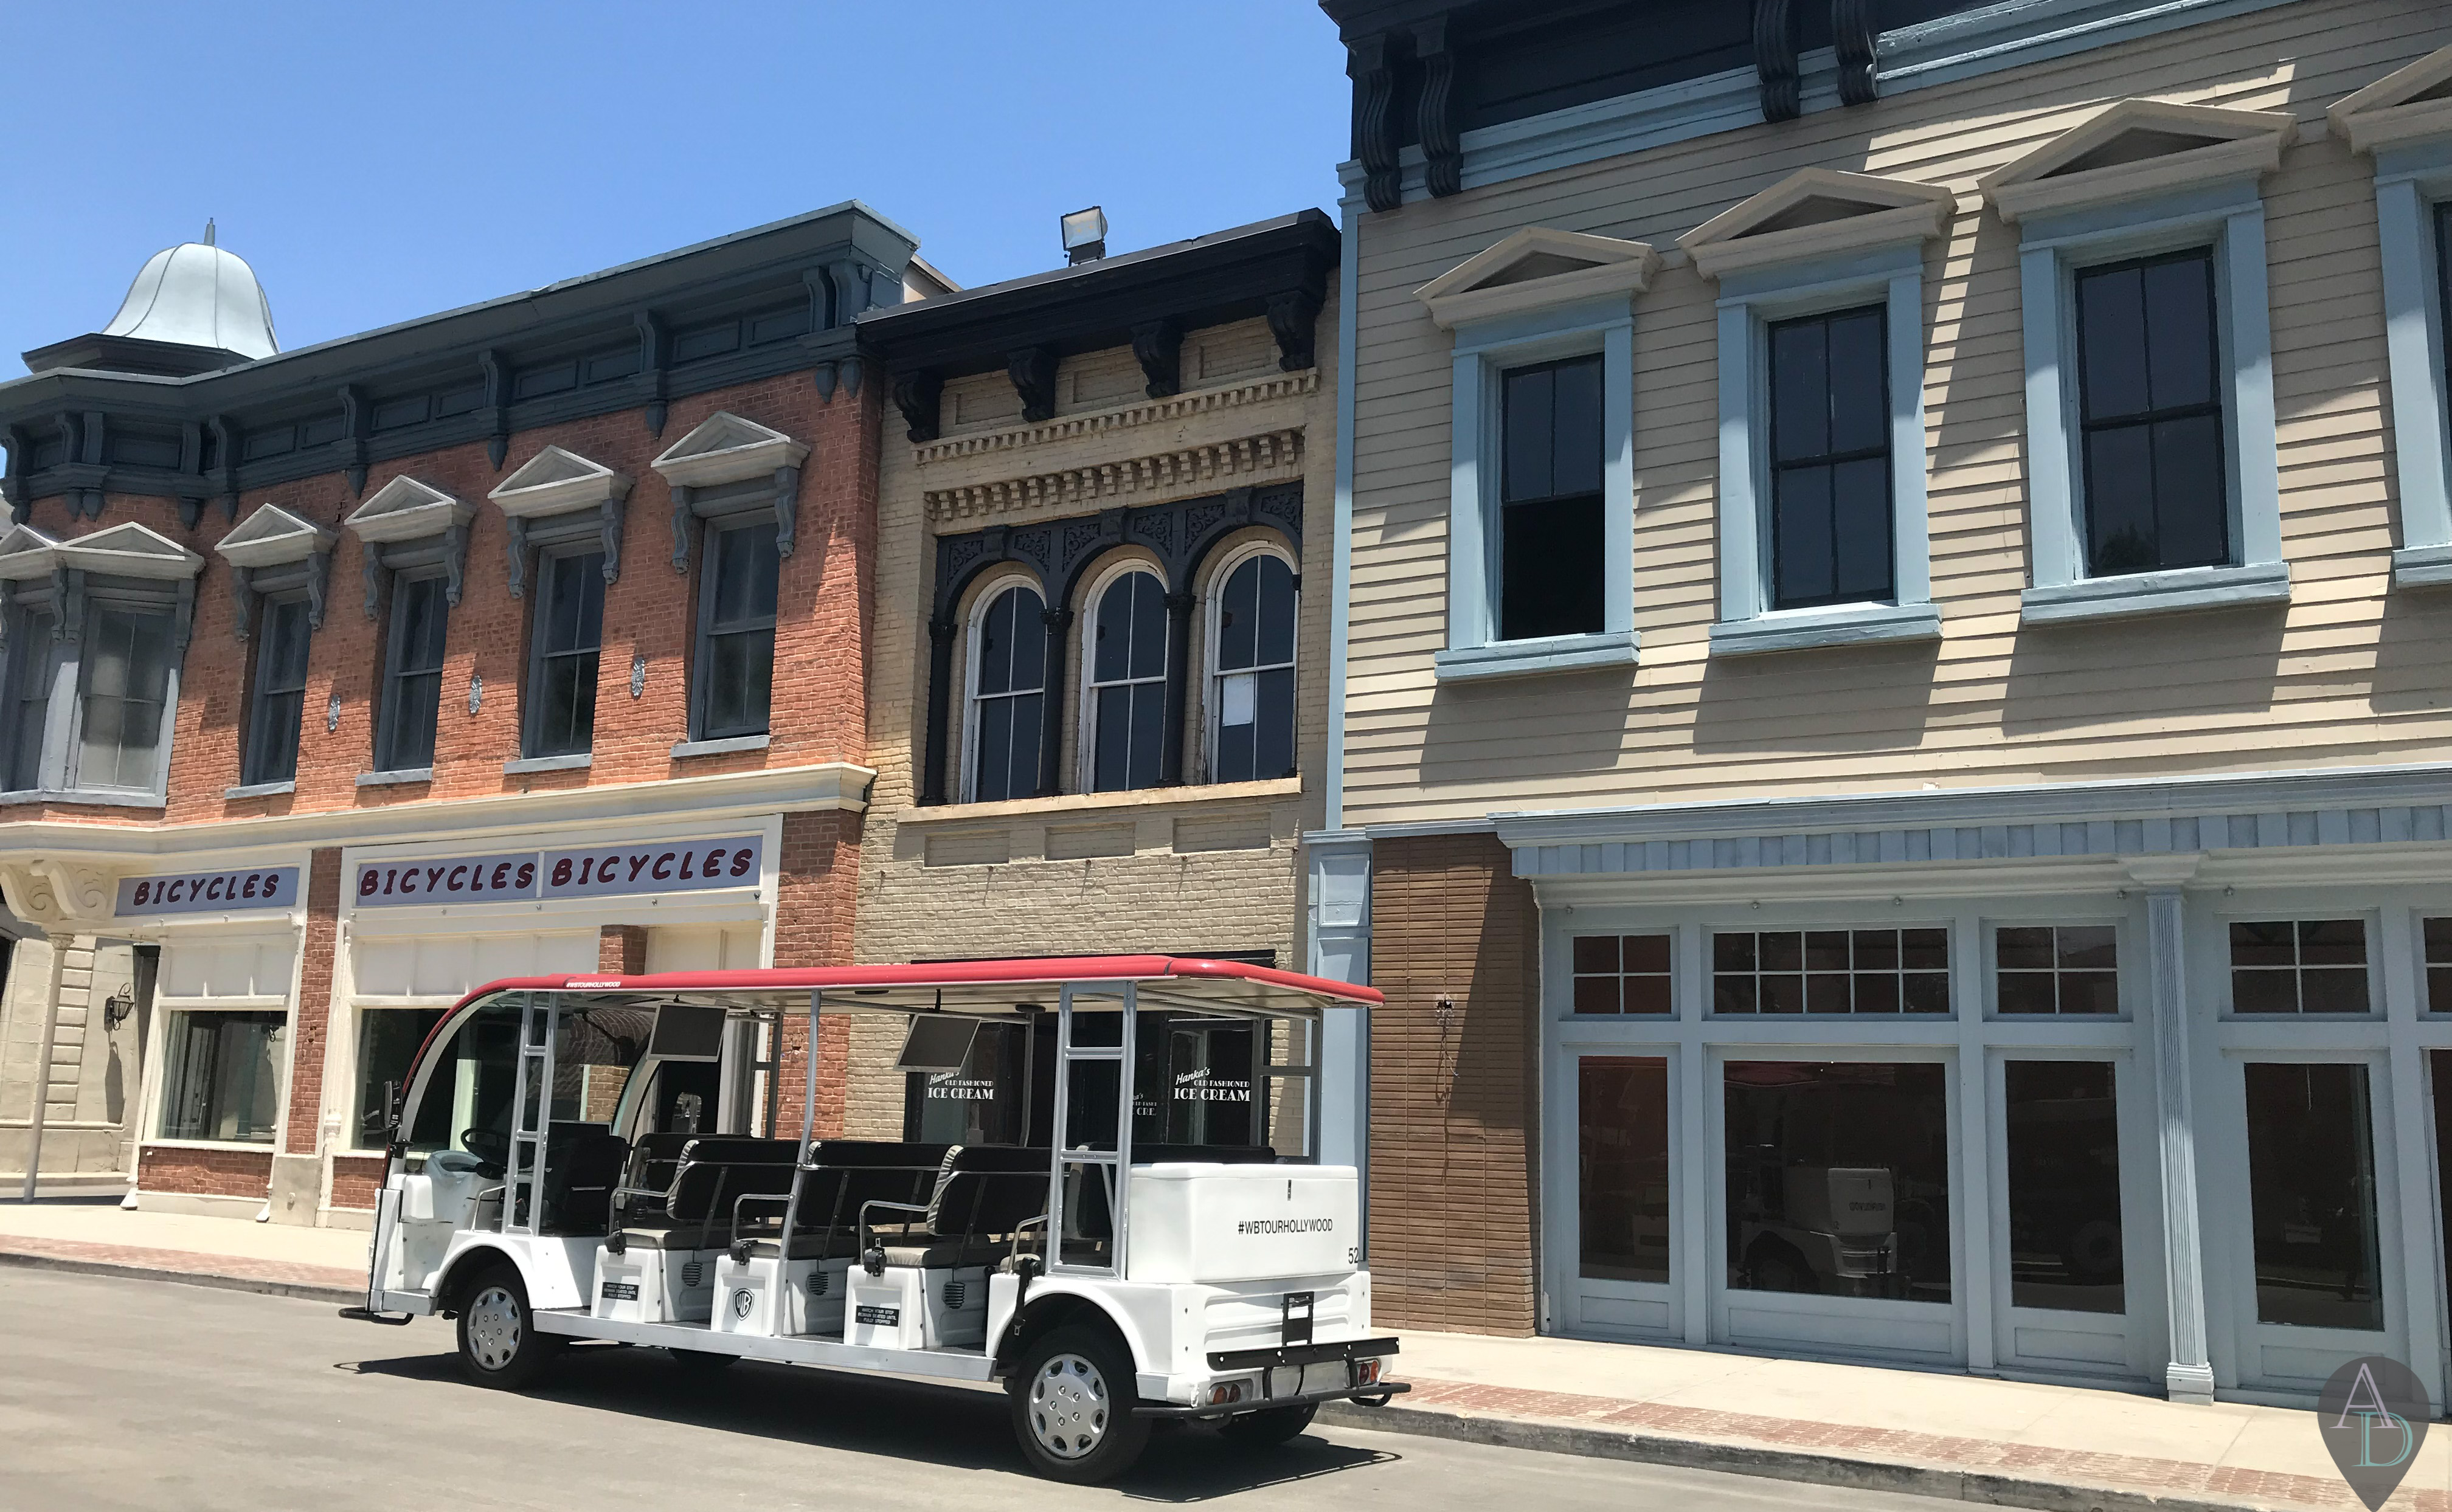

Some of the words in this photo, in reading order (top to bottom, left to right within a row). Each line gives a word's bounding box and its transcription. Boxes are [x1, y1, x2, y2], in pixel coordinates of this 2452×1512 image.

[550, 848, 753, 887] BICYCLES
[359, 862, 535, 897] BICYCLES
[133, 874, 280, 906] BICYCLES
[1175, 1066, 1210, 1085] Hanka's
[927, 1087, 947, 1099] ICE
[951, 1088, 994, 1100] CREAM
[1173, 1088, 1197, 1100] ICE
[1200, 1089, 1250, 1102] CREAM
[1238, 1218, 1333, 1235] #WBTOURHOLLYWOOD
[1348, 1247, 1358, 1265] 52
[735, 1291, 752, 1317] WB
